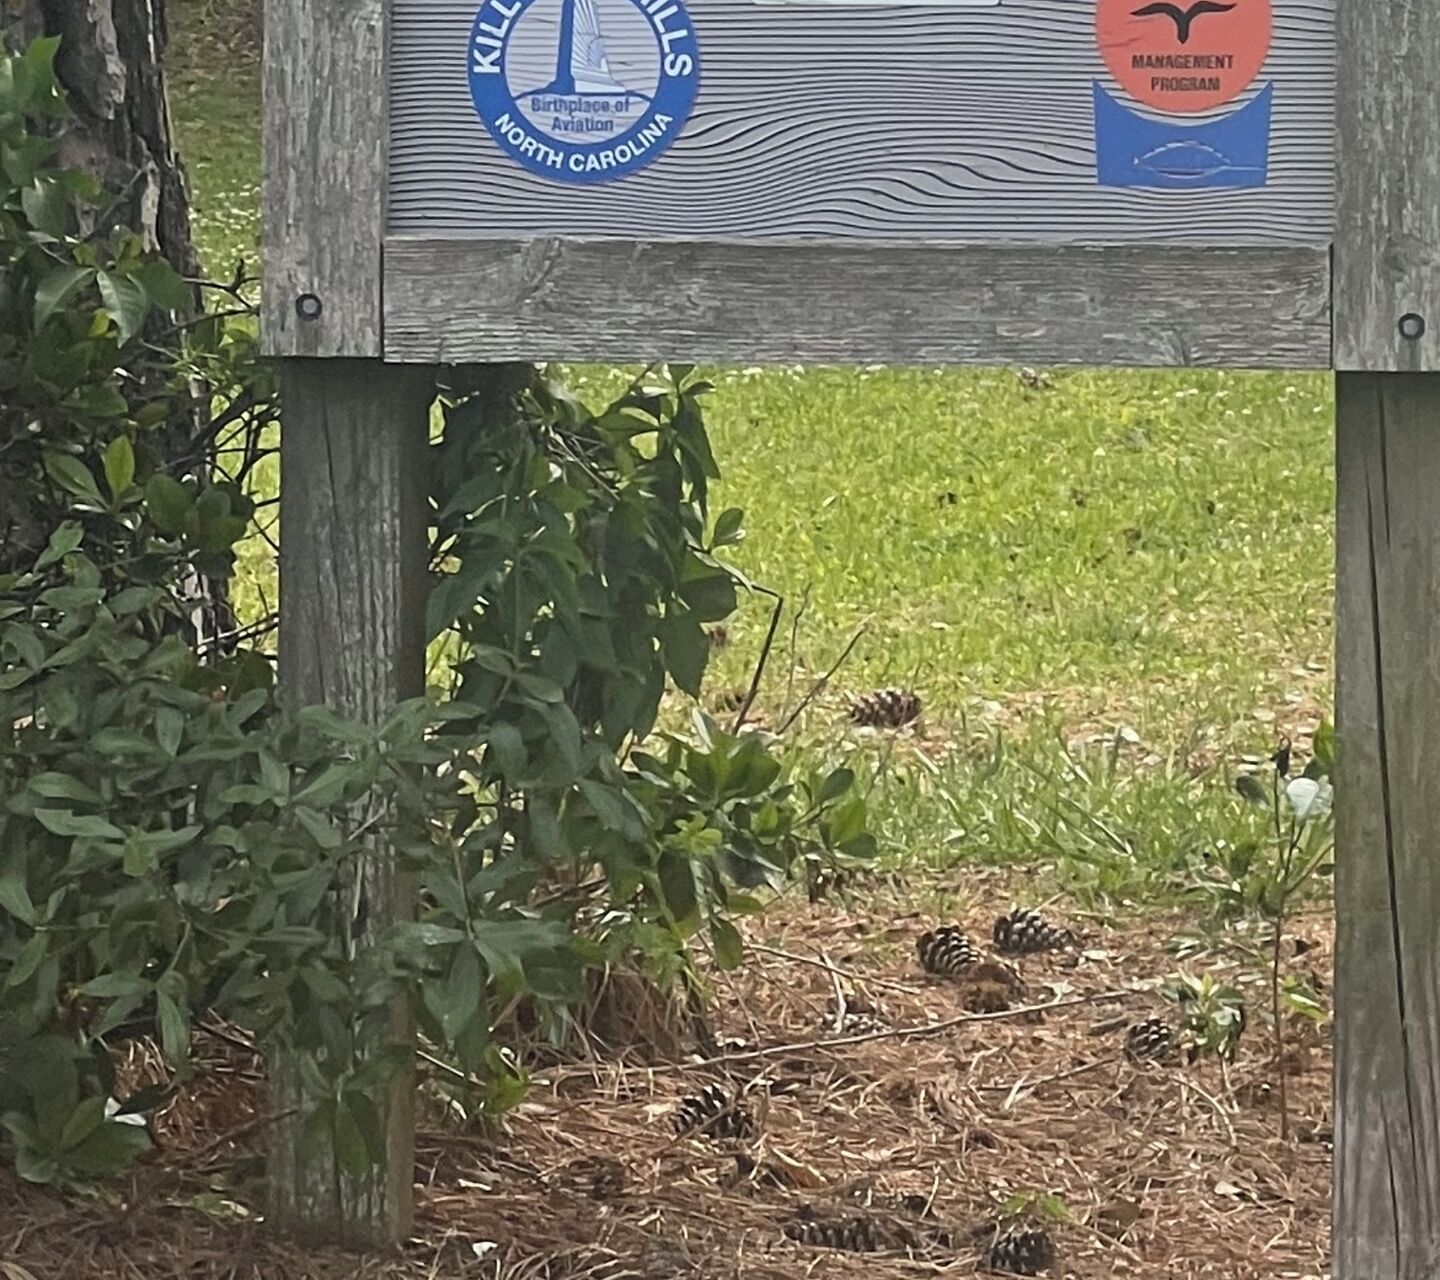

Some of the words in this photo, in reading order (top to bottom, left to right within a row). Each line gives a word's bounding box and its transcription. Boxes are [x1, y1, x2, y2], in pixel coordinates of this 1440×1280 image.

[1131, 54, 1234, 70] MANAGEMENT
[1151, 76, 1220, 91] PROGRAM
[531, 96, 610, 116] Birthplace
[614, 96, 631, 113] of
[551, 116, 614, 133] Aviation
[494, 112, 564, 170] NORTH
[568, 112, 673, 172] CAROLINA
